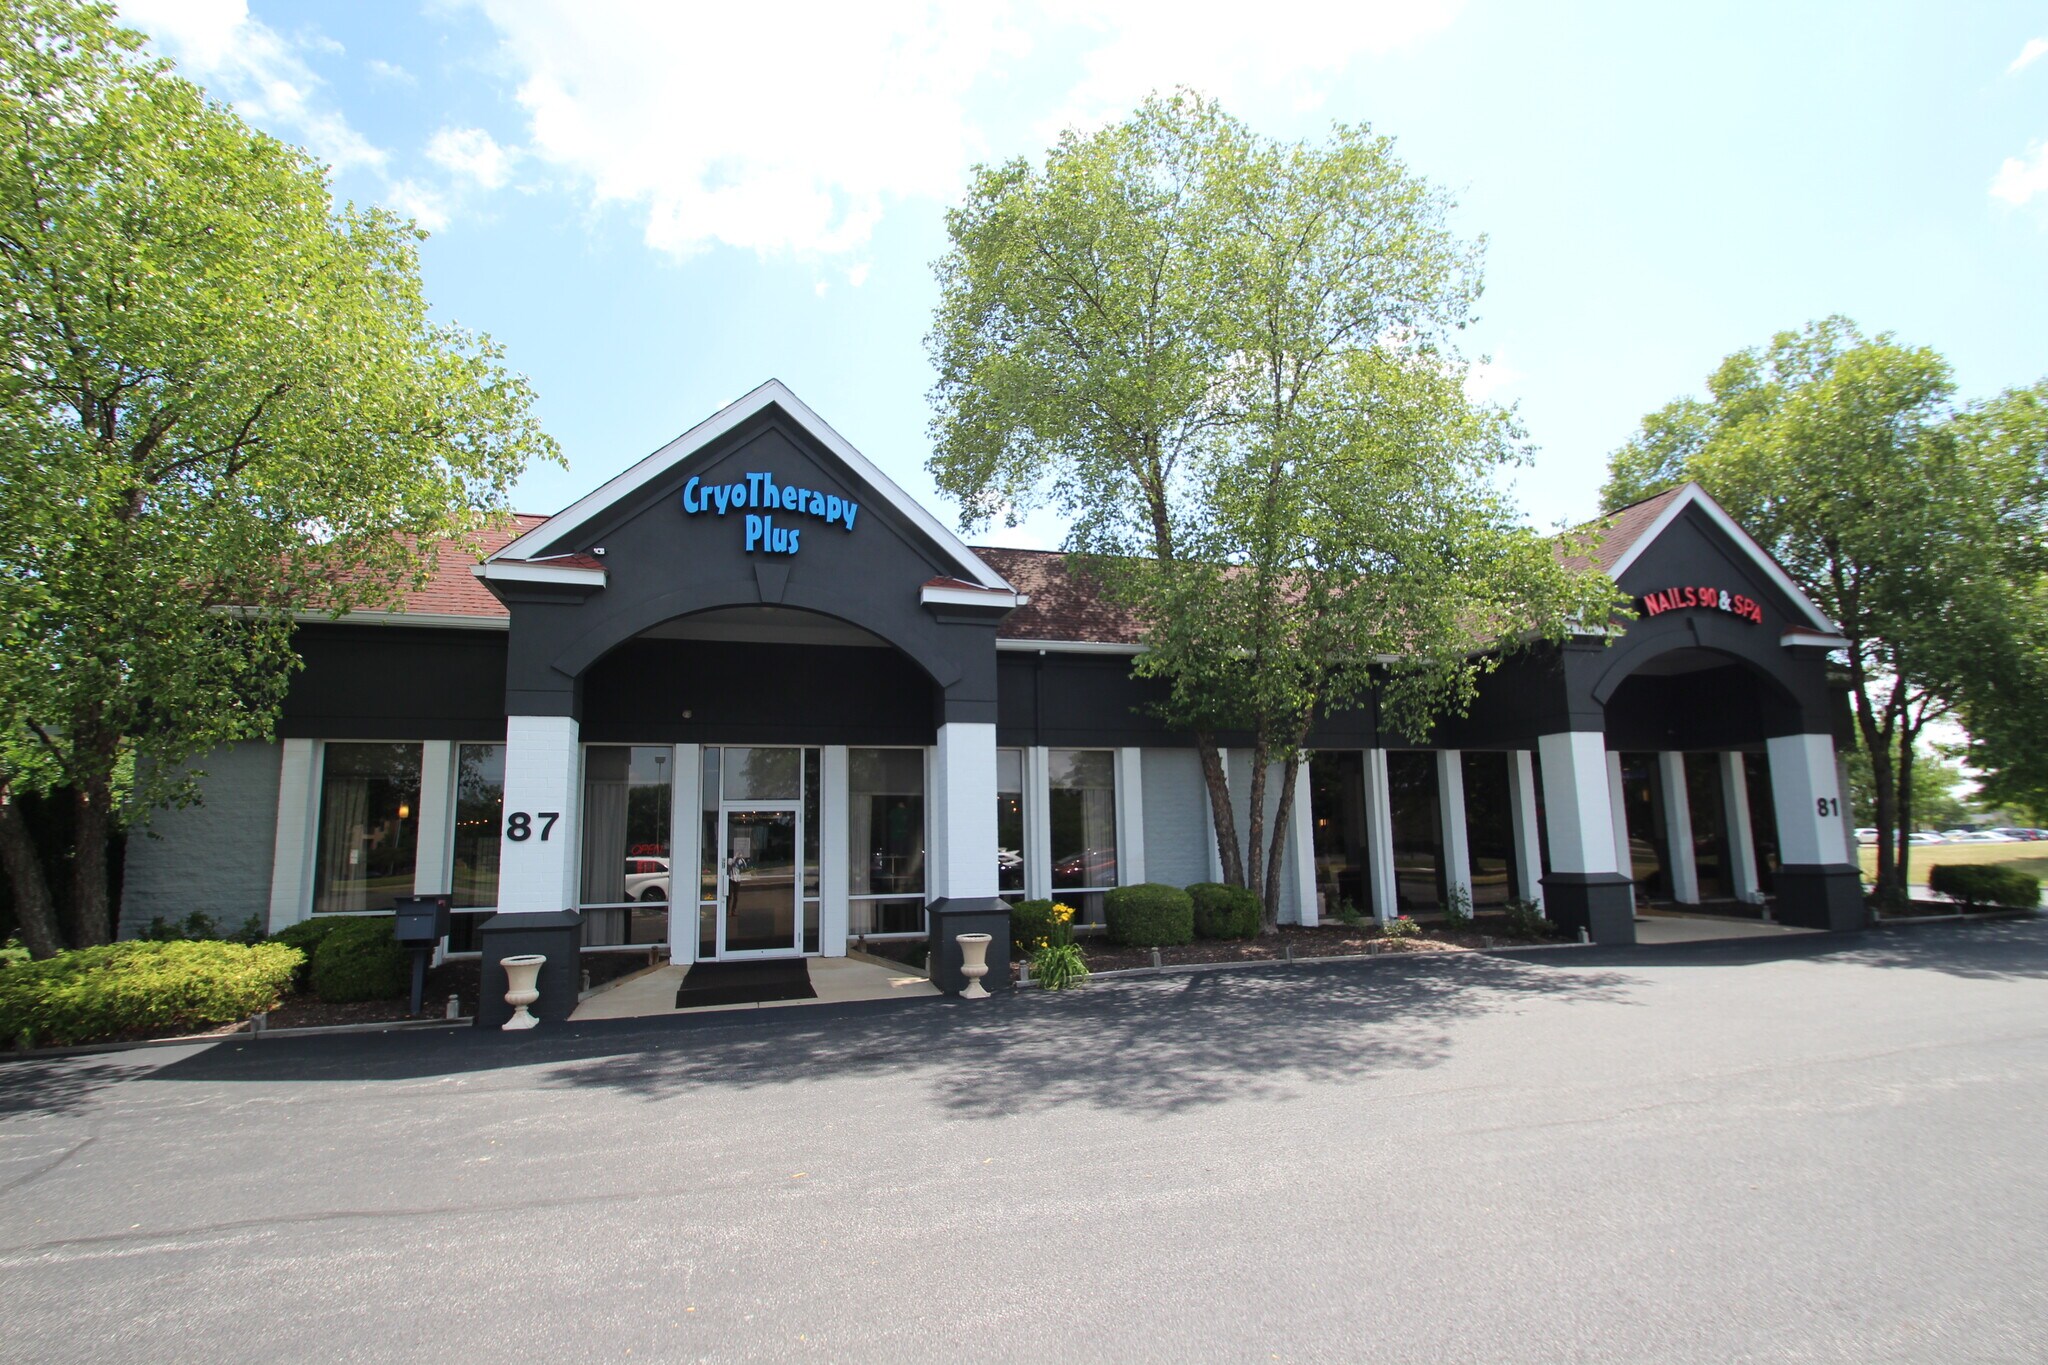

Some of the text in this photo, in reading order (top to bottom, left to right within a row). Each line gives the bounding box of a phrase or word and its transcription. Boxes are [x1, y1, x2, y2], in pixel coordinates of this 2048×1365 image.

[683, 472, 858, 531] CryoTherapy
[745, 514, 799, 554] Plus
[1643, 586, 1763, 625] NAILS 90 & SPA
[506, 811, 560, 842] 87
[1817, 797, 1839, 817] 81
